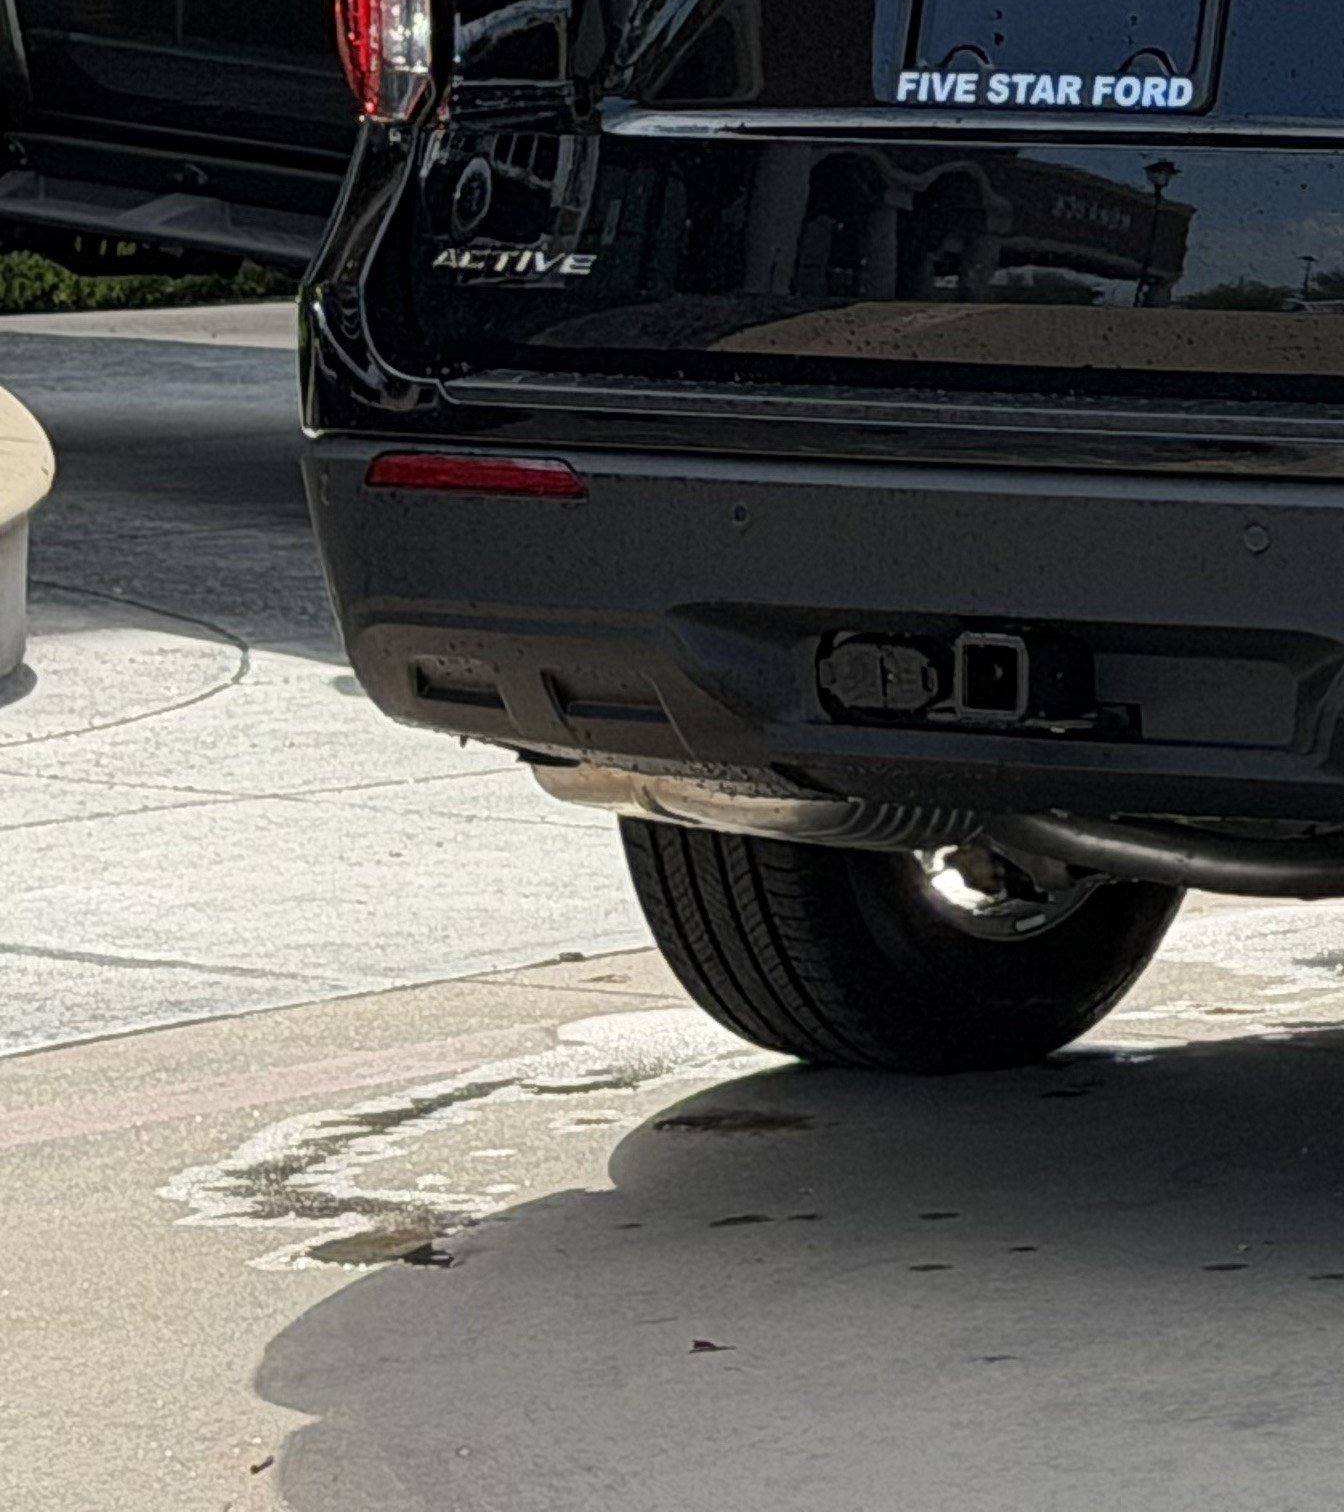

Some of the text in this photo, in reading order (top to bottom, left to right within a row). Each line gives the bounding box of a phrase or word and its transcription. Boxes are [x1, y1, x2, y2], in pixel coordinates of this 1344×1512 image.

[896, 71, 1194, 108] FIVE STAR FORD
[431, 248, 598, 276] ACTIVE
